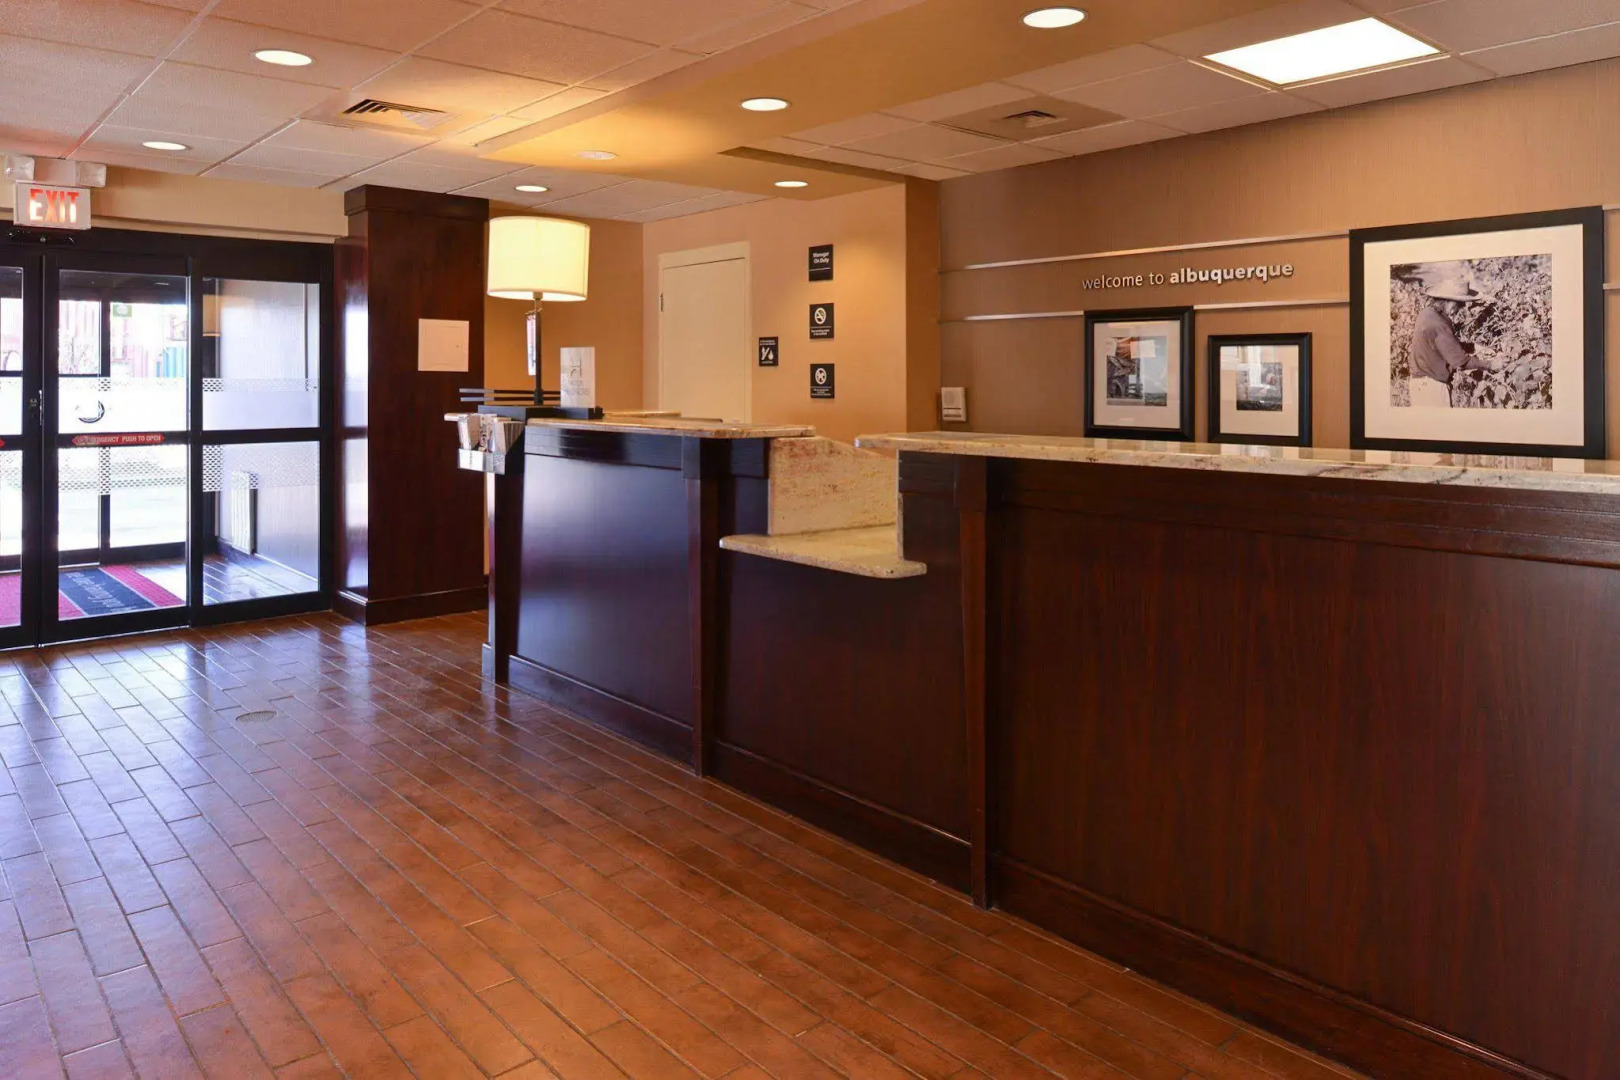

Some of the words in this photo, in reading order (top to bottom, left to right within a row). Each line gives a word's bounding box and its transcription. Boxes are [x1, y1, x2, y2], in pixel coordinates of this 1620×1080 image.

[30, 188, 79, 223] EXIT
[1082, 274, 1144, 290] welcome
[1150, 272, 1164, 285] to
[1170, 263, 1294, 285] albuquerque
